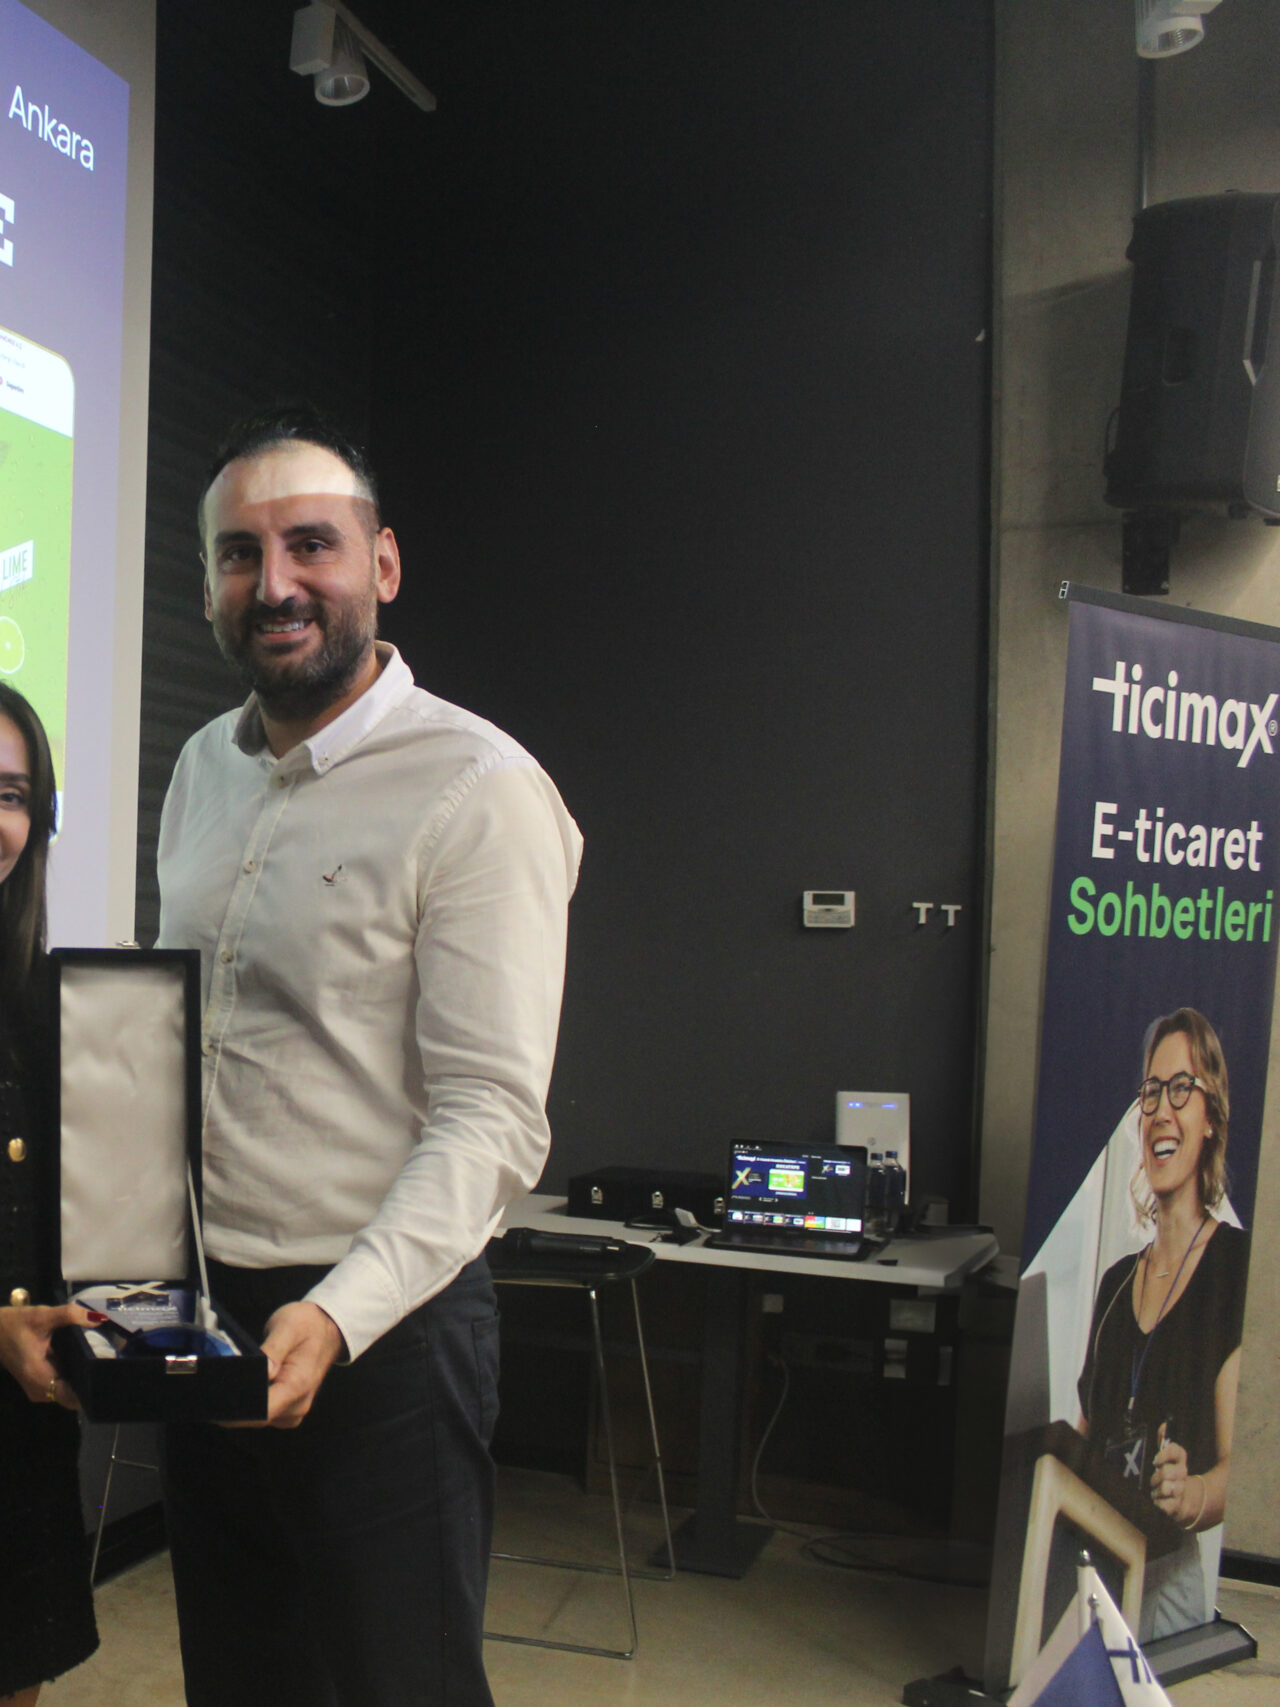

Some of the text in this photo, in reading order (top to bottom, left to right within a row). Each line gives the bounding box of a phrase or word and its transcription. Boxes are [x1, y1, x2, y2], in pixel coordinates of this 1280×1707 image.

[9, 85, 95, 171] Ankara
[2, 549, 28, 580] LIME
[1092, 660, 1278, 768] ticimax
[1091, 801, 1263, 872] E-ticaret
[1067, 876, 1274, 942] Sohbetleri
